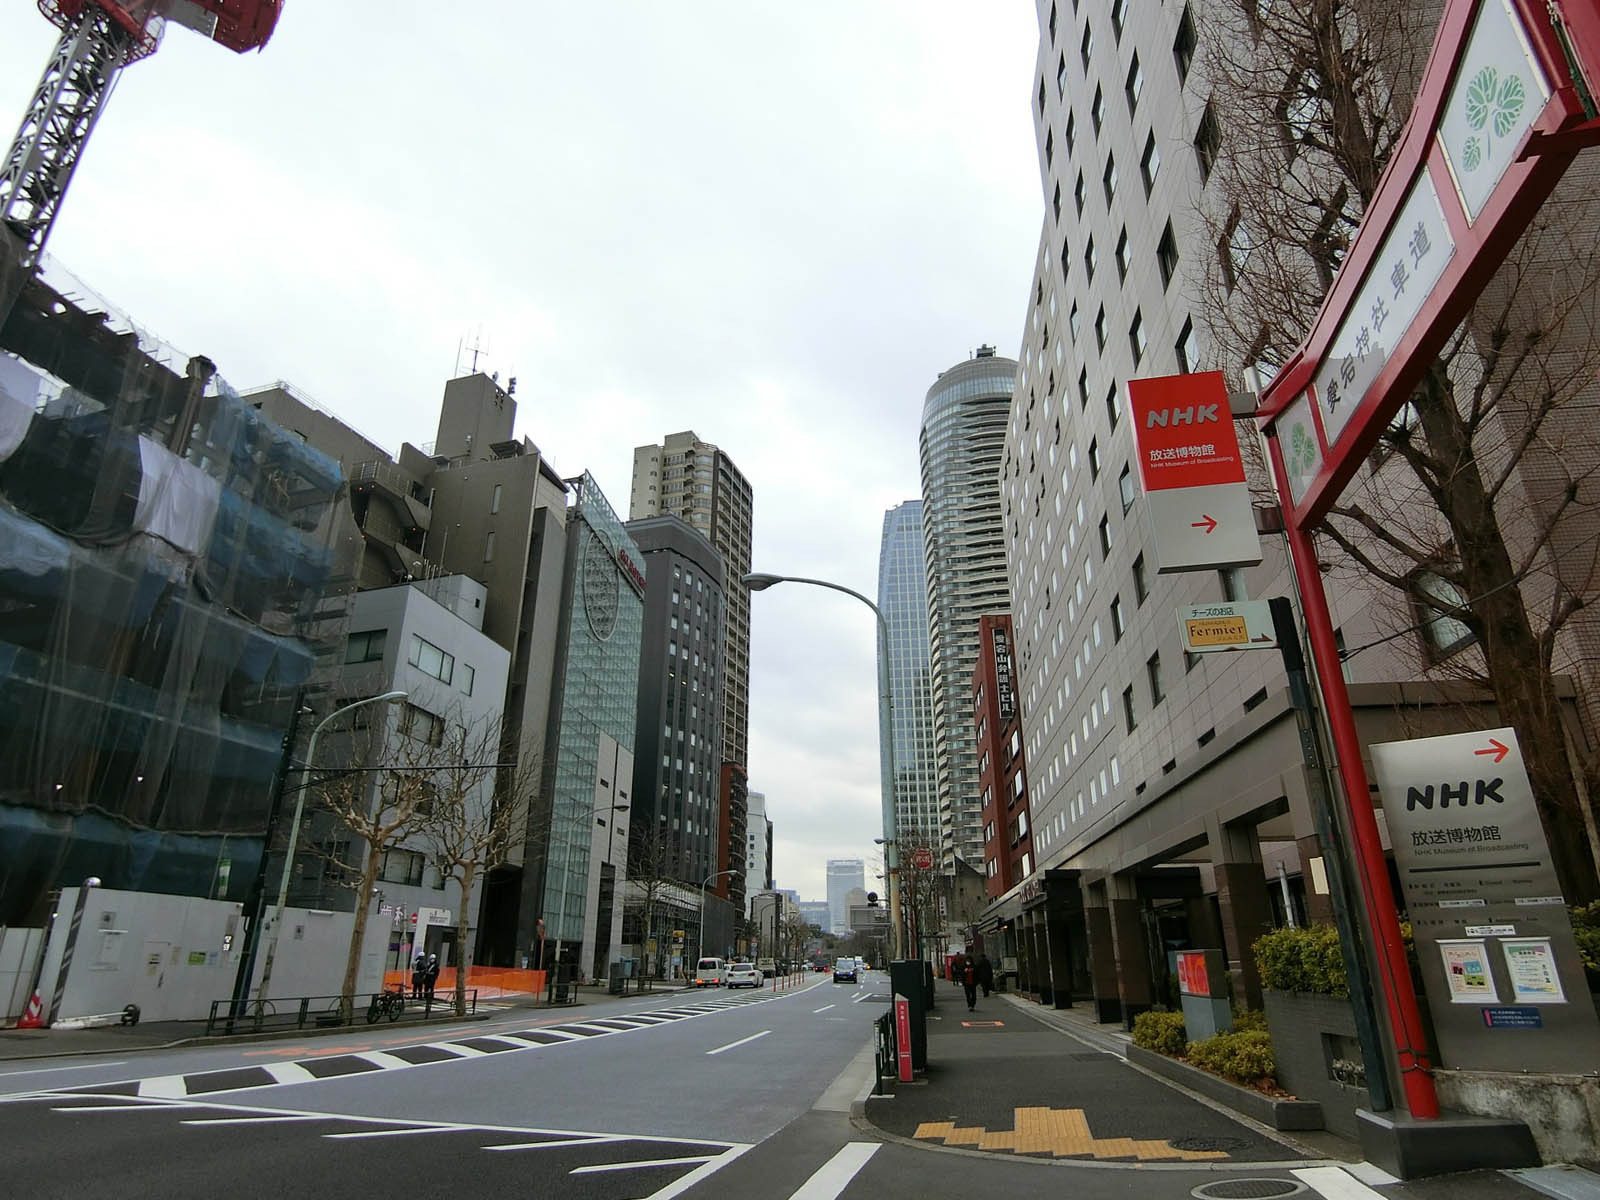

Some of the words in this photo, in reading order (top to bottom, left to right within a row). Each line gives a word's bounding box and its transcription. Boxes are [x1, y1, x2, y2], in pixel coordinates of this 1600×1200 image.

[1326, 221, 1432, 414] 愛宕神社車道
[1146, 403, 1219, 429] NHK
[1149, 444, 1216, 461] 放送博物館
[1191, 606, 1234, 618] チーズのお店
[1189, 624, 1244, 637] Fermier
[1406, 777, 1505, 812] NHK
[1410, 825, 1502, 847] 放送博物館
[1414, 848, 1432, 856] NHK
[1476, 843, 1529, 852] Broadcasting
